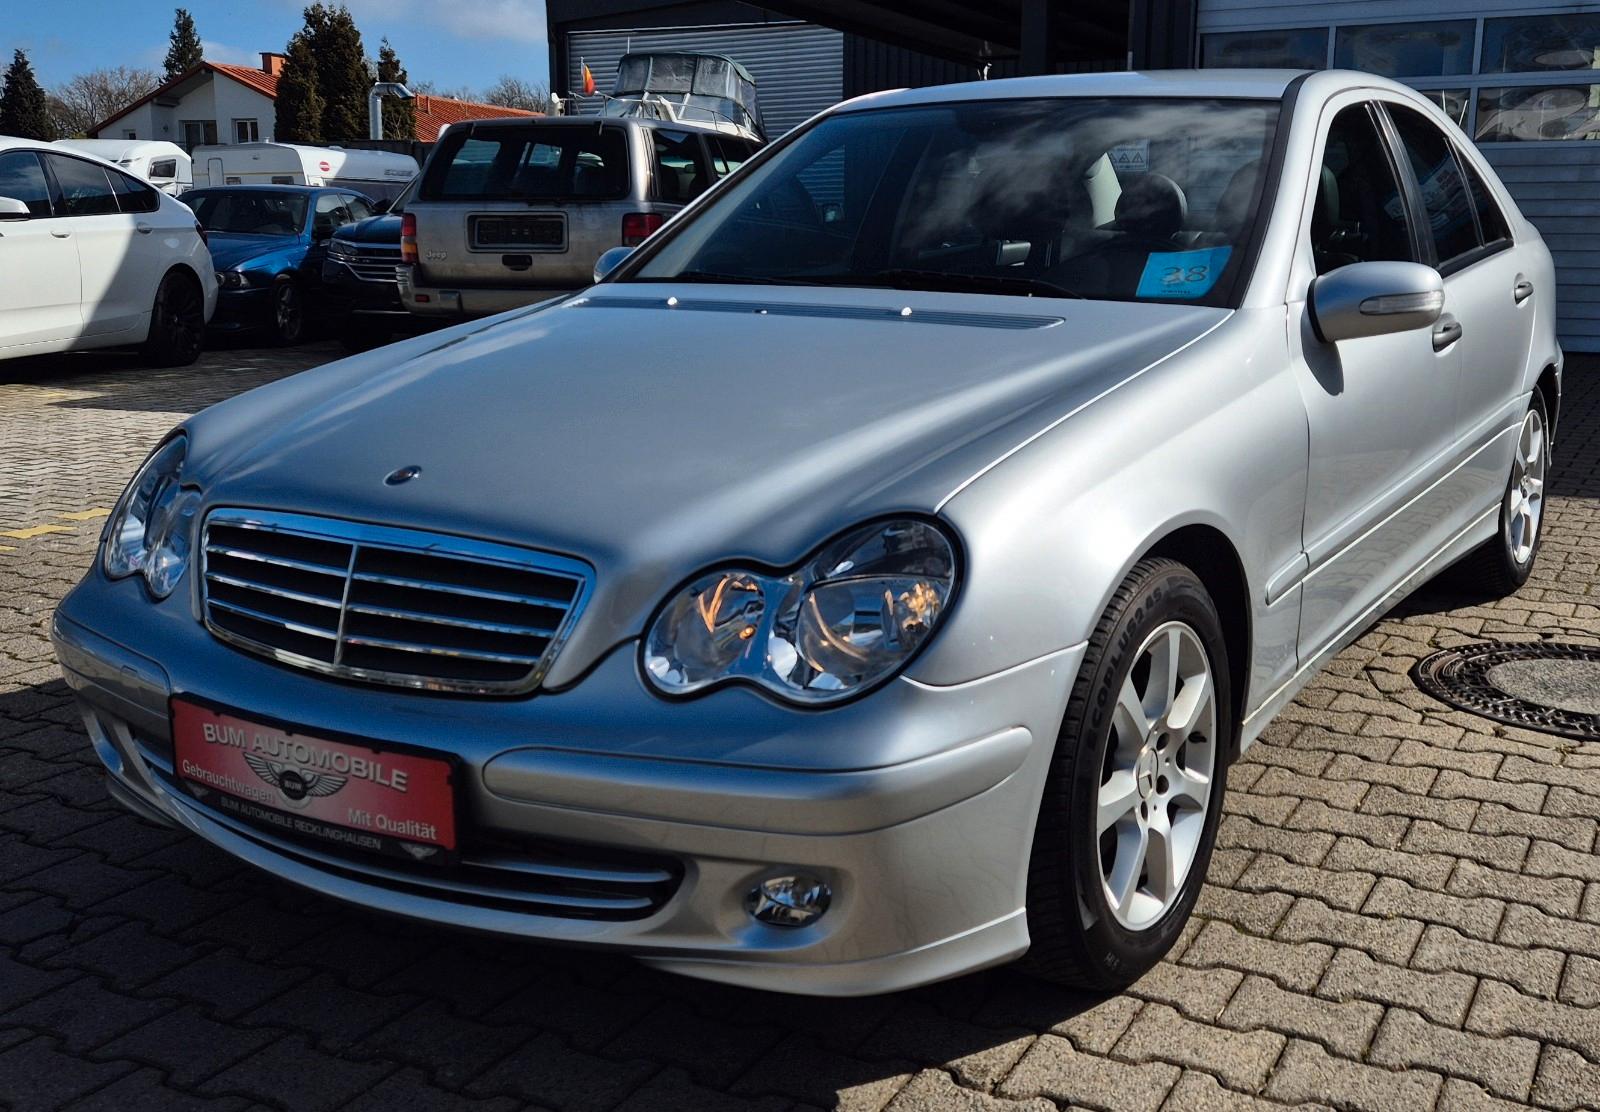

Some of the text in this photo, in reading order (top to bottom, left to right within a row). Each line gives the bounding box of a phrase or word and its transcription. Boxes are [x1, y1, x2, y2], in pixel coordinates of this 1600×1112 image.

[425, 249, 447, 259] Jeep
[203, 722, 408, 792] BUM AUTOMOBILE
[182, 759, 274, 802] Gebrauchtwagen
[284, 780, 302, 791] BUM
[220, 796, 381, 850] BUM AUTOMOBILE RECKLINGHAUSEN
[348, 809, 437, 840] Mit Qualität
